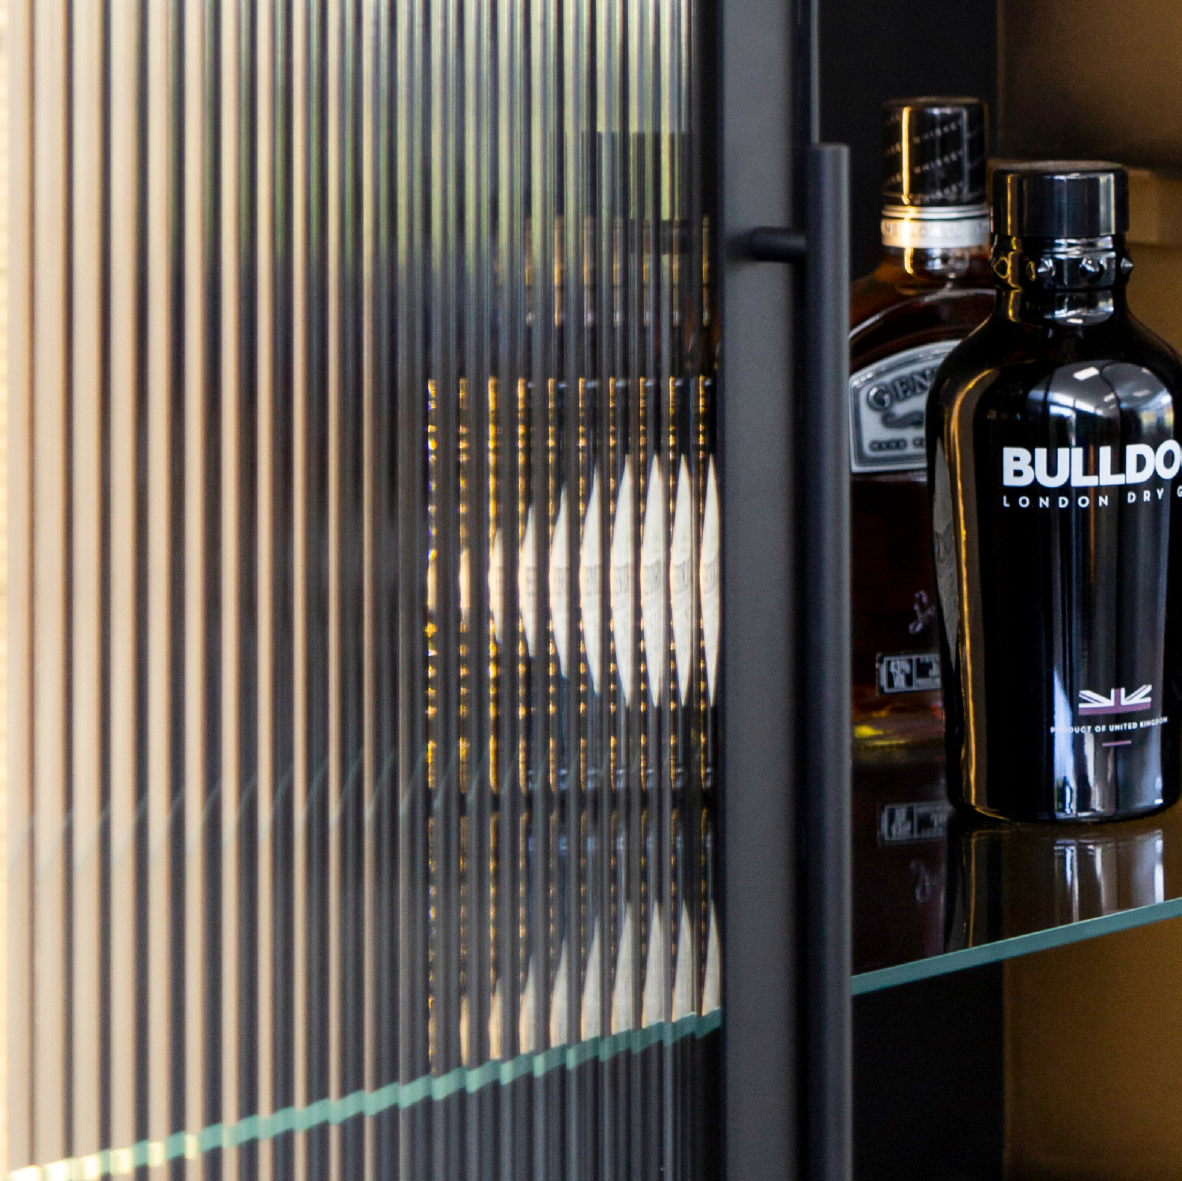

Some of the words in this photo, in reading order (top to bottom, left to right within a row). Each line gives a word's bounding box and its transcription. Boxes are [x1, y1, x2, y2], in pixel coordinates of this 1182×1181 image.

[866, 368, 937, 412] GEN
[1002, 495, 1109, 509] LONDON
[1127, 487, 1165, 504] DRY
[1094, 724, 1106, 733] OF
[1109, 722, 1138, 732] UNITED
